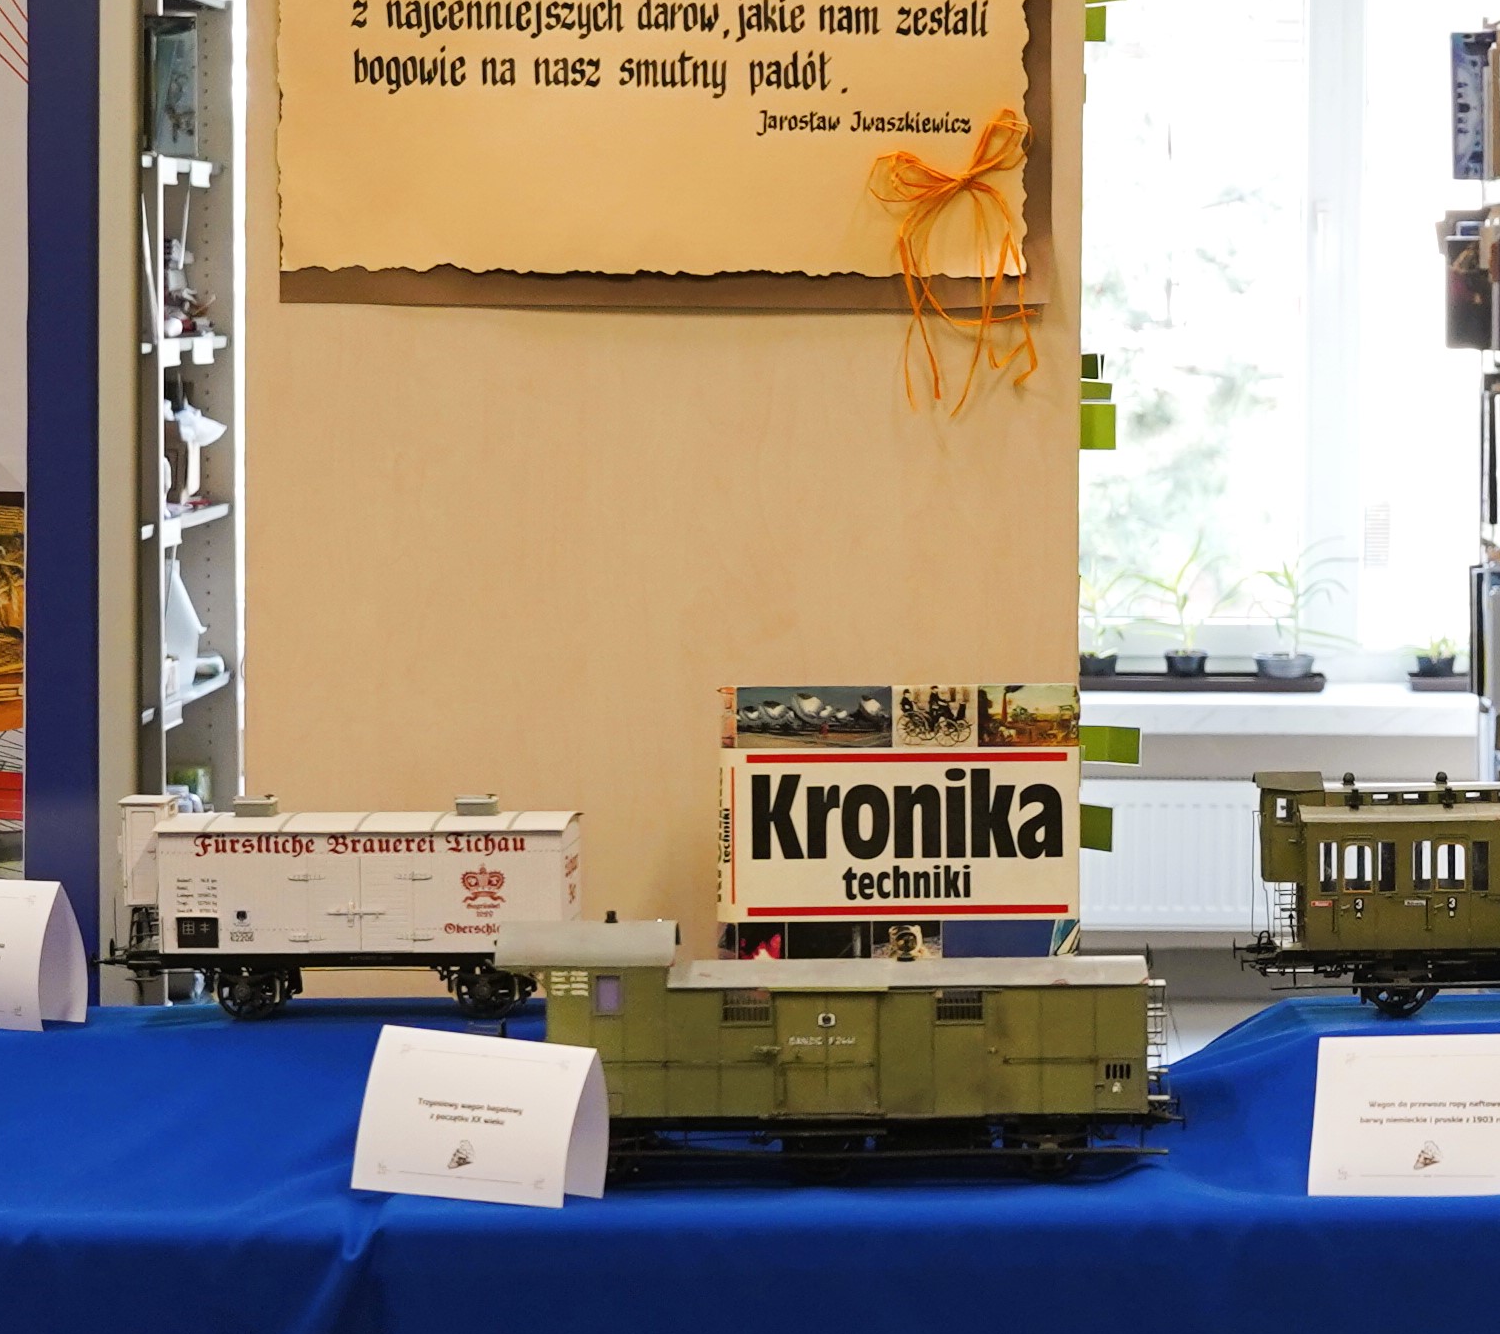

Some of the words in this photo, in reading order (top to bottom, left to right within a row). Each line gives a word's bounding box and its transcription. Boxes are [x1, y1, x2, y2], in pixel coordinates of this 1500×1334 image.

[819, 4, 880, 35] nam
[895, 0, 989, 38] zesłali
[353, 45, 467, 95] bogowie
[481, 57, 516, 87] na
[534, 57, 601, 88] nasz
[618, 50, 727, 99] smutny
[756, 109, 841, 137] Jarosław
[751, 768, 1064, 860] Kronika
[327, 834, 437, 855] Brauerei
[444, 833, 528, 856] Tichau
[842, 864, 972, 901] techniki
[1356, 898, 1363, 910] 3
[1449, 897, 1456, 909] 3
